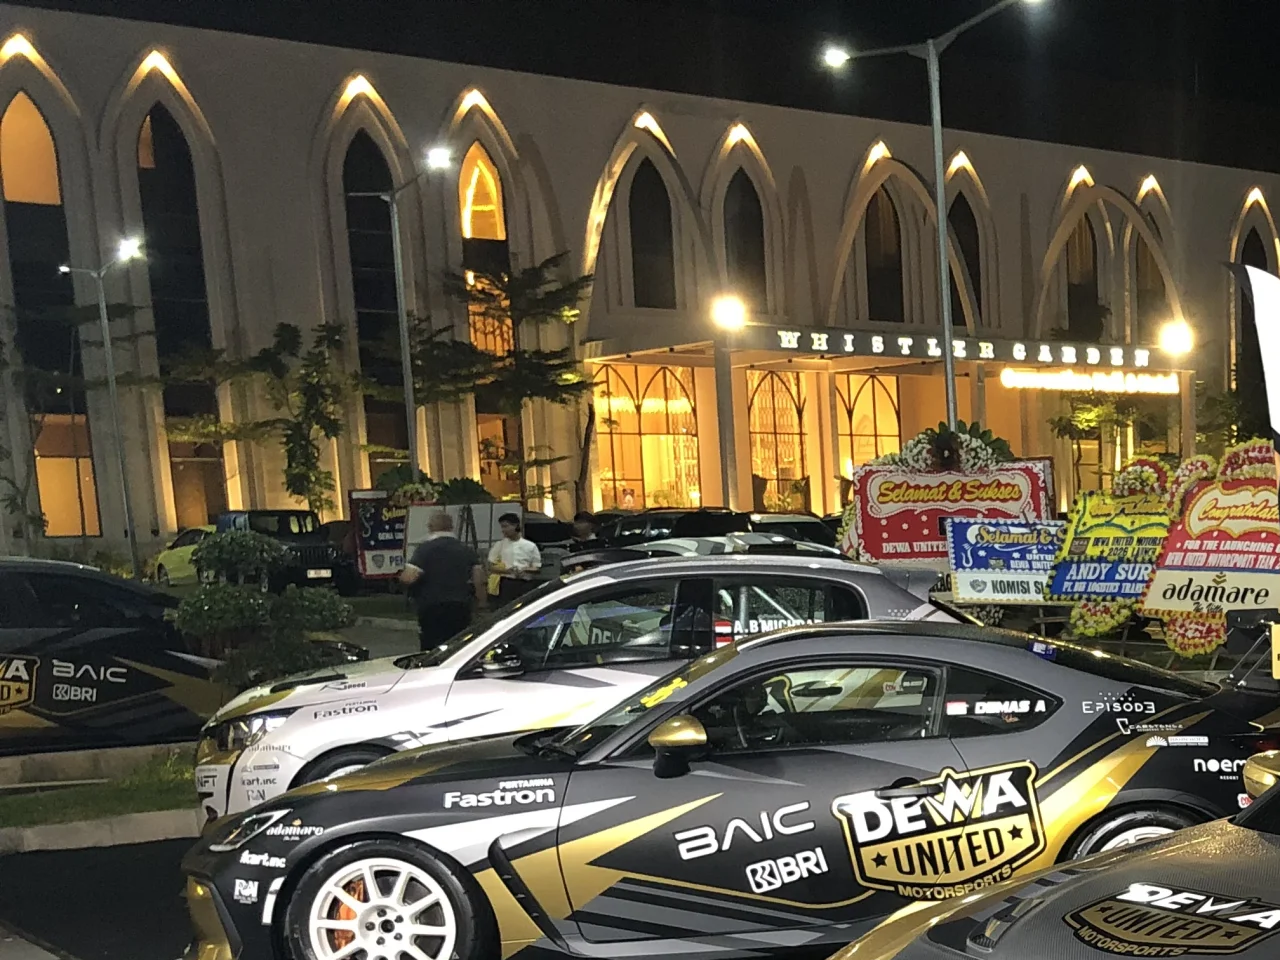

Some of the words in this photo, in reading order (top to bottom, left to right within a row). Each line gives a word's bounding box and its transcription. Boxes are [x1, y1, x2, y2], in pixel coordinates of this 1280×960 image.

[778, 330, 995, 359] WHISTLER
[1013, 343, 1150, 367] GARDEN
[877, 480, 946, 504] Selamat
[948, 480, 962, 500] &
[964, 479, 1022, 501] Sukses
[977, 526, 1038, 544] Selamat
[882, 542, 911, 554] DEWA
[913, 540, 948, 553] UNITE
[1183, 540, 1203, 551] FOR
[1203, 540, 1219, 551] THE
[1219, 541, 1274, 553] LAUNCHING
[1031, 560, 1055, 570] UNITE
[1065, 563, 1112, 580] ANDY
[991, 580, 1031, 594] KOMISI
[1162, 578, 1270, 605] adamare
[52, 659, 128, 683] BAIC
[70, 686, 97, 702] BRI
[313, 705, 378, 720] Fastron
[1082, 701, 1156, 714] EPISODE
[499, 778, 555, 789] PERTAMINA
[443, 788, 555, 809] Fastron
[846, 771, 1028, 843] DEWA
[674, 801, 815, 860] BAIC
[892, 828, 1005, 876] UNITED
[776, 847, 829, 884] BRI
[898, 865, 1012, 899] MOTORSPORTS
[1102, 907, 1224, 940] UNITED
[1078, 926, 1188, 956] MOTORSPORTS
